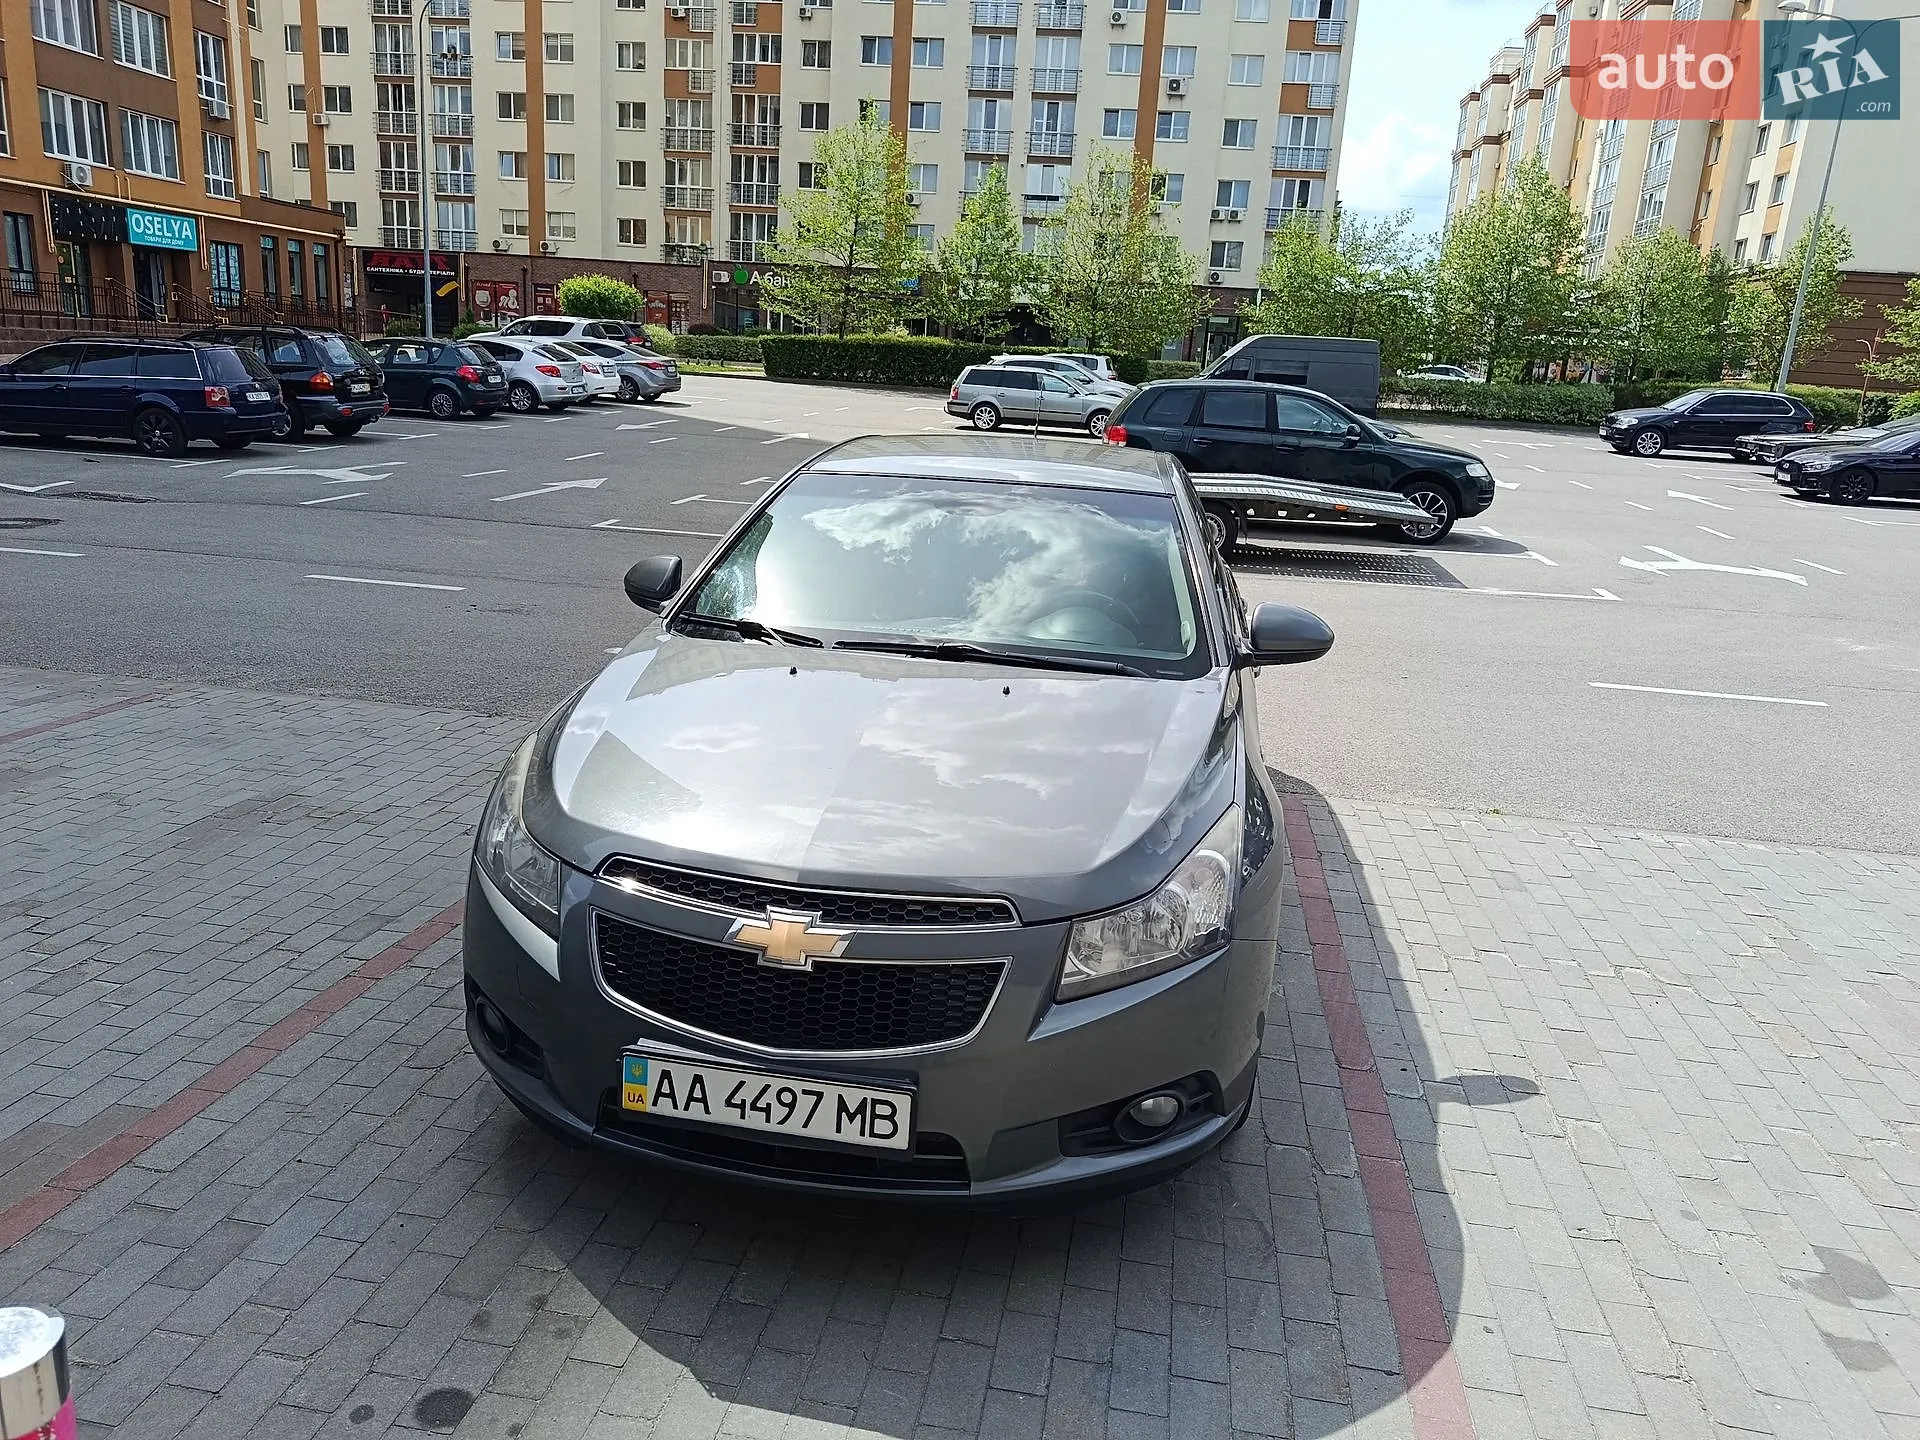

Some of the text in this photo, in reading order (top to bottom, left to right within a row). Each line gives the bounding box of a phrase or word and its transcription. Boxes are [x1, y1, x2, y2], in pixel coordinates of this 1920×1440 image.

[131, 213, 193, 240] OSELYA
[366, 266, 404, 274] САНТЕХНІКА
[627, 1091, 645, 1105] UA
[651, 1069, 900, 1140] AA 4497 MB
